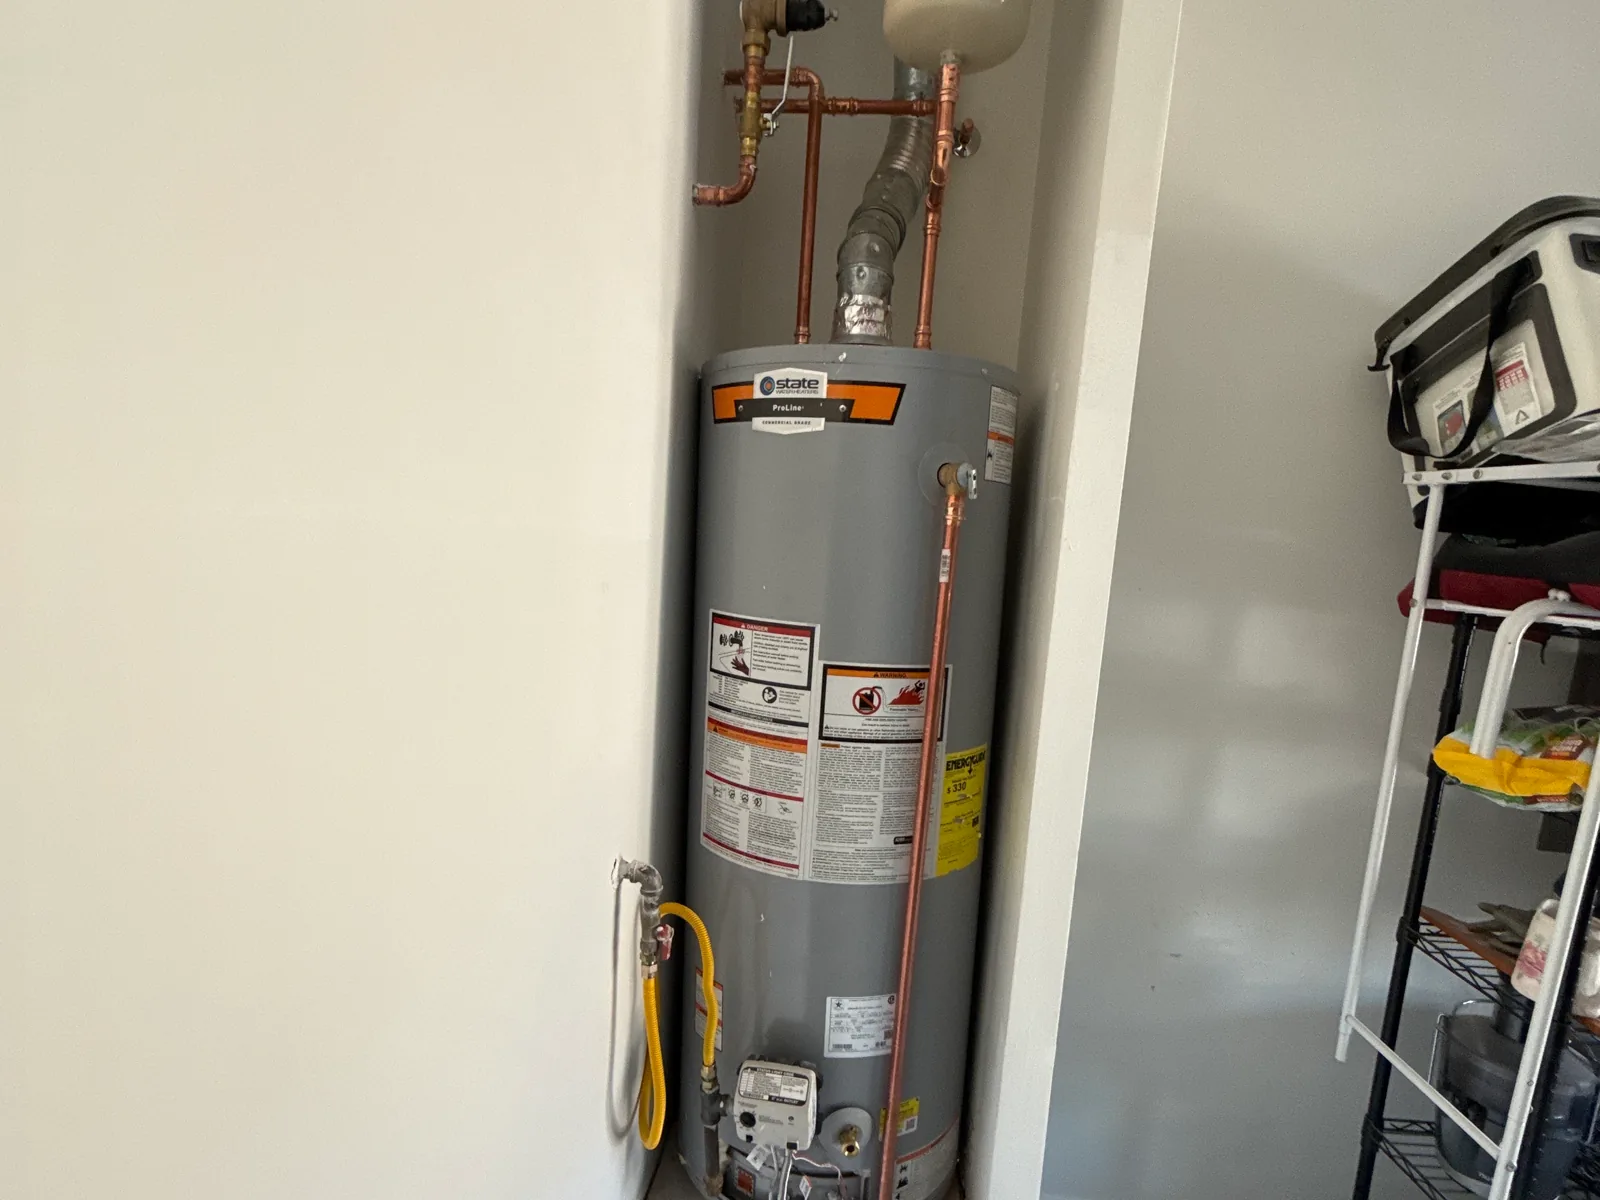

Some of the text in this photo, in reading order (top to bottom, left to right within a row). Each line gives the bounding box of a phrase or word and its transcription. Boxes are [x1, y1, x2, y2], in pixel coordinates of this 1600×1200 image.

[776, 378, 819, 389] state
[772, 404, 802, 412] ProLine
[746, 624, 768, 632] DANGER
